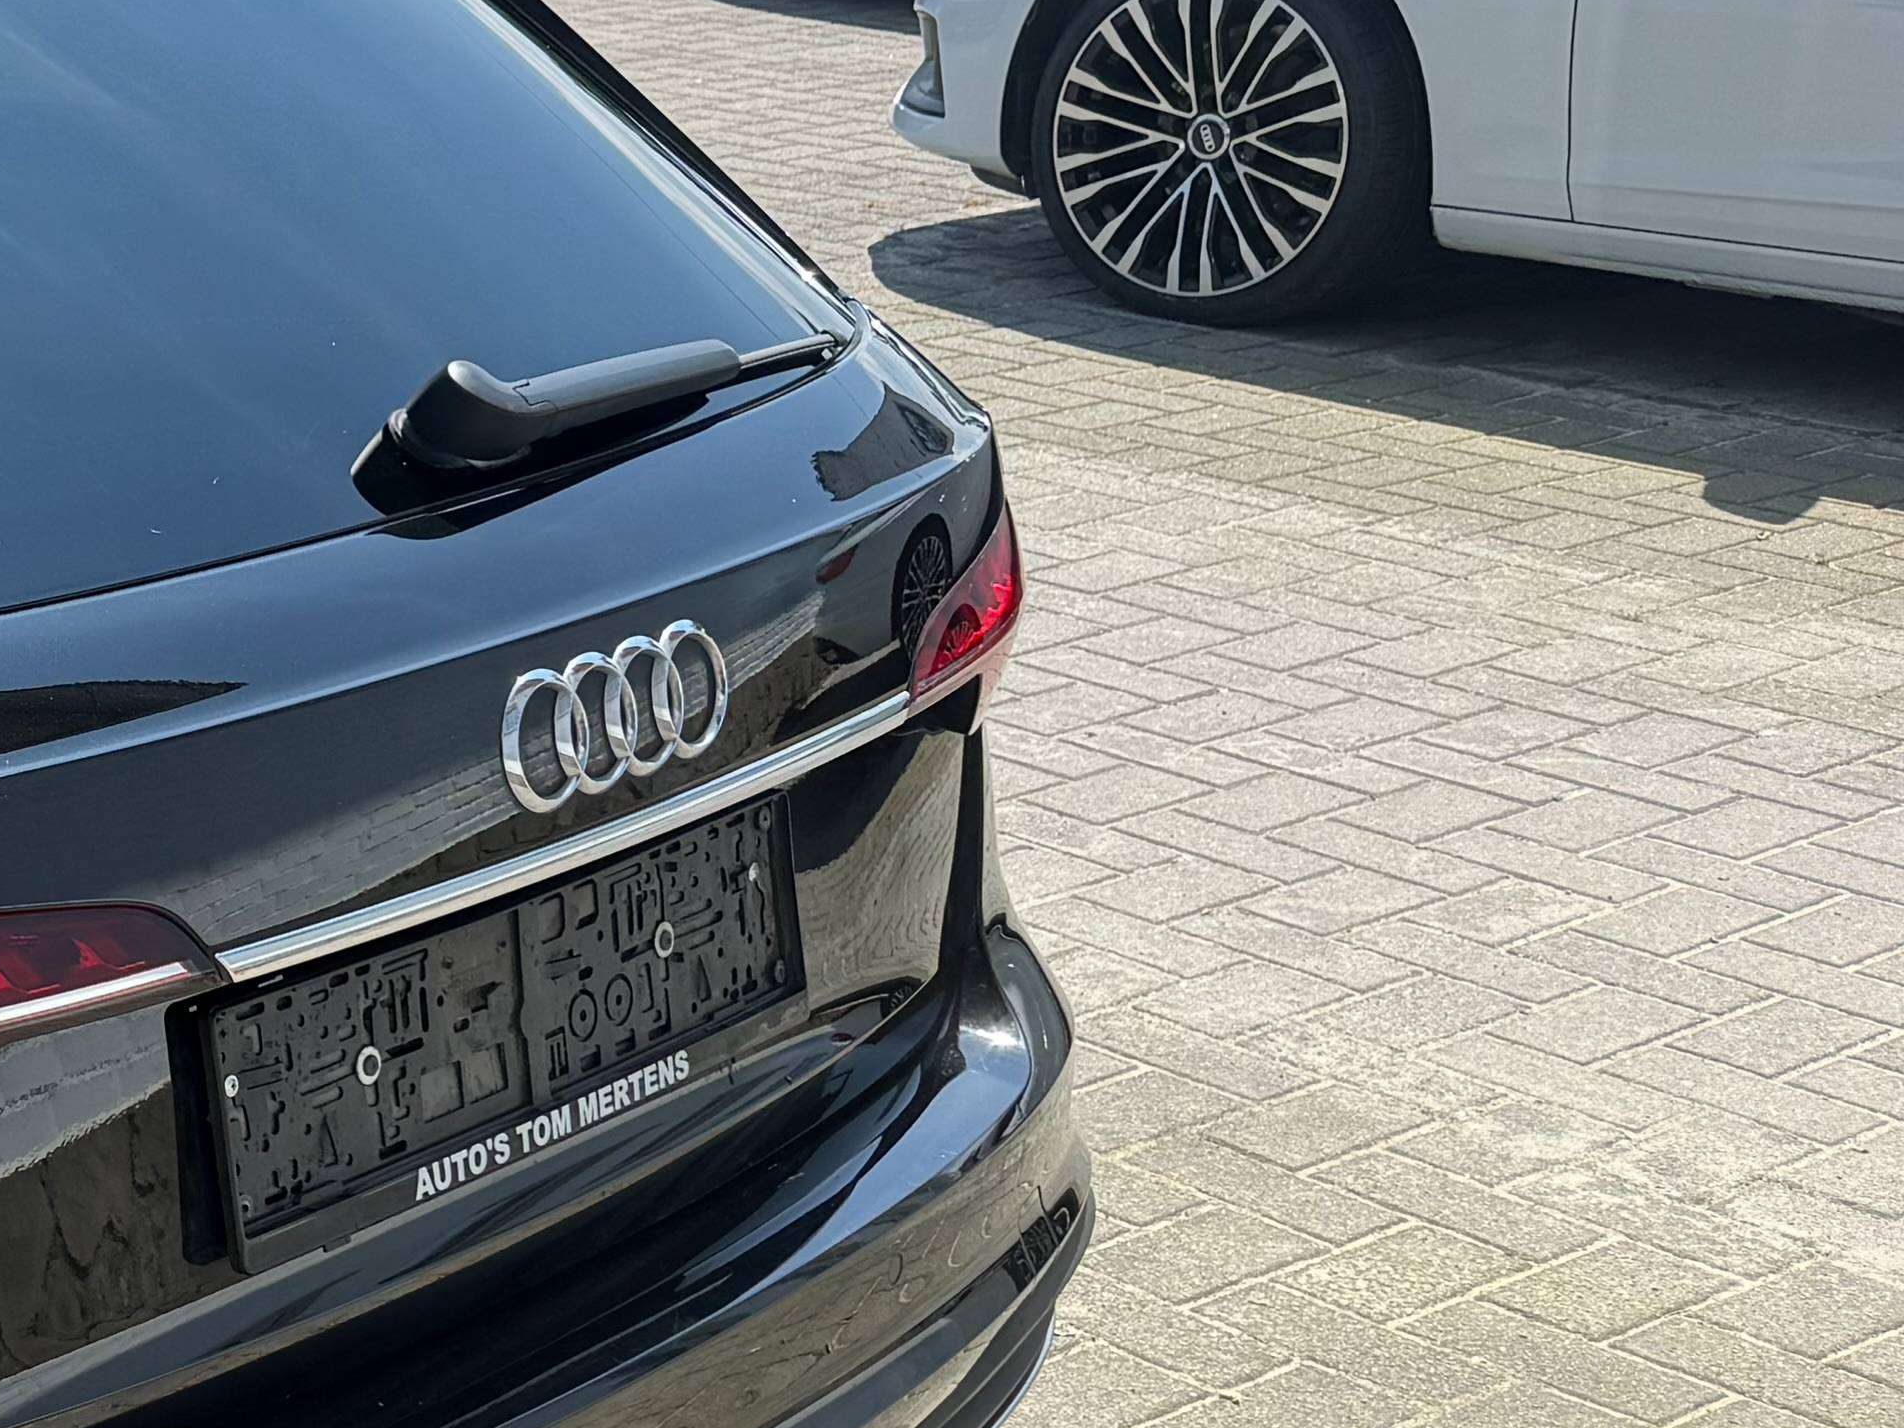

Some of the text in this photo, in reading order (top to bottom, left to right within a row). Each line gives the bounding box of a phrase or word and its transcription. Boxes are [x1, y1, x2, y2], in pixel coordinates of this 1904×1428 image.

[415, 1049, 690, 1202] AUTO'S TOM MERTENS
